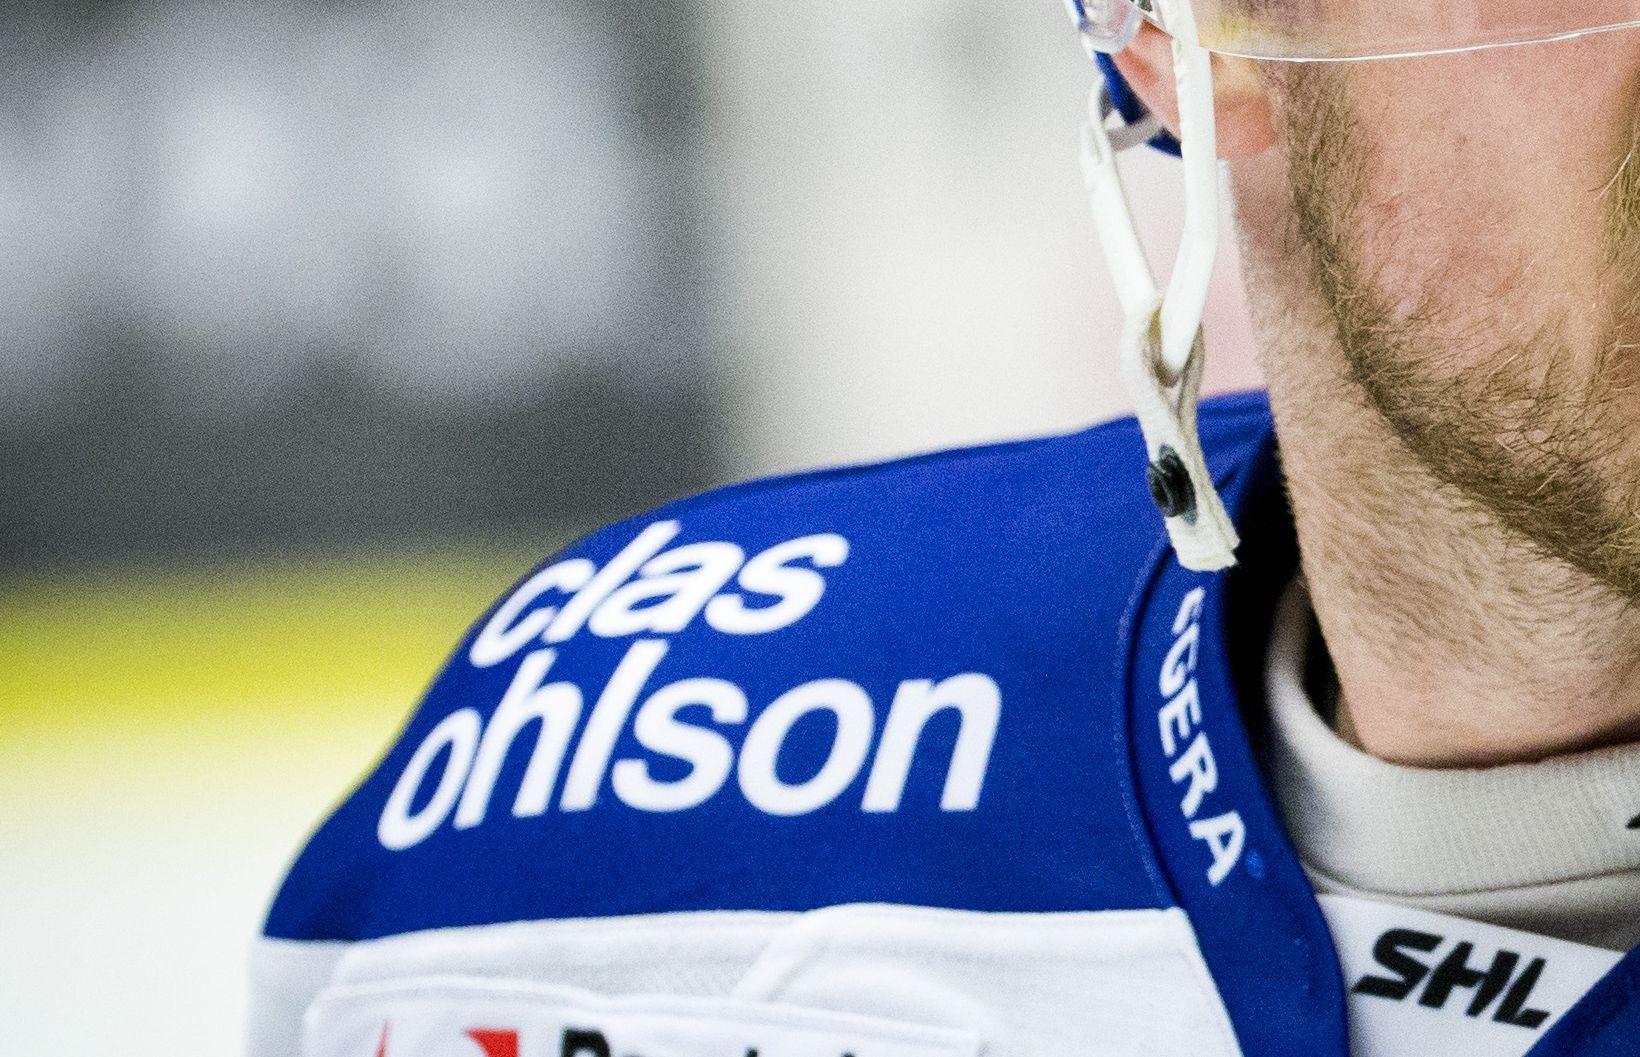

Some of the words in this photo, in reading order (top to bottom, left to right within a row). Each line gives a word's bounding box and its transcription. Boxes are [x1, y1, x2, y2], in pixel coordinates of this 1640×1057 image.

[469, 519, 850, 667] clas
[377, 639, 1002, 850] ohlson
[1351, 927, 1551, 1030] SHL
